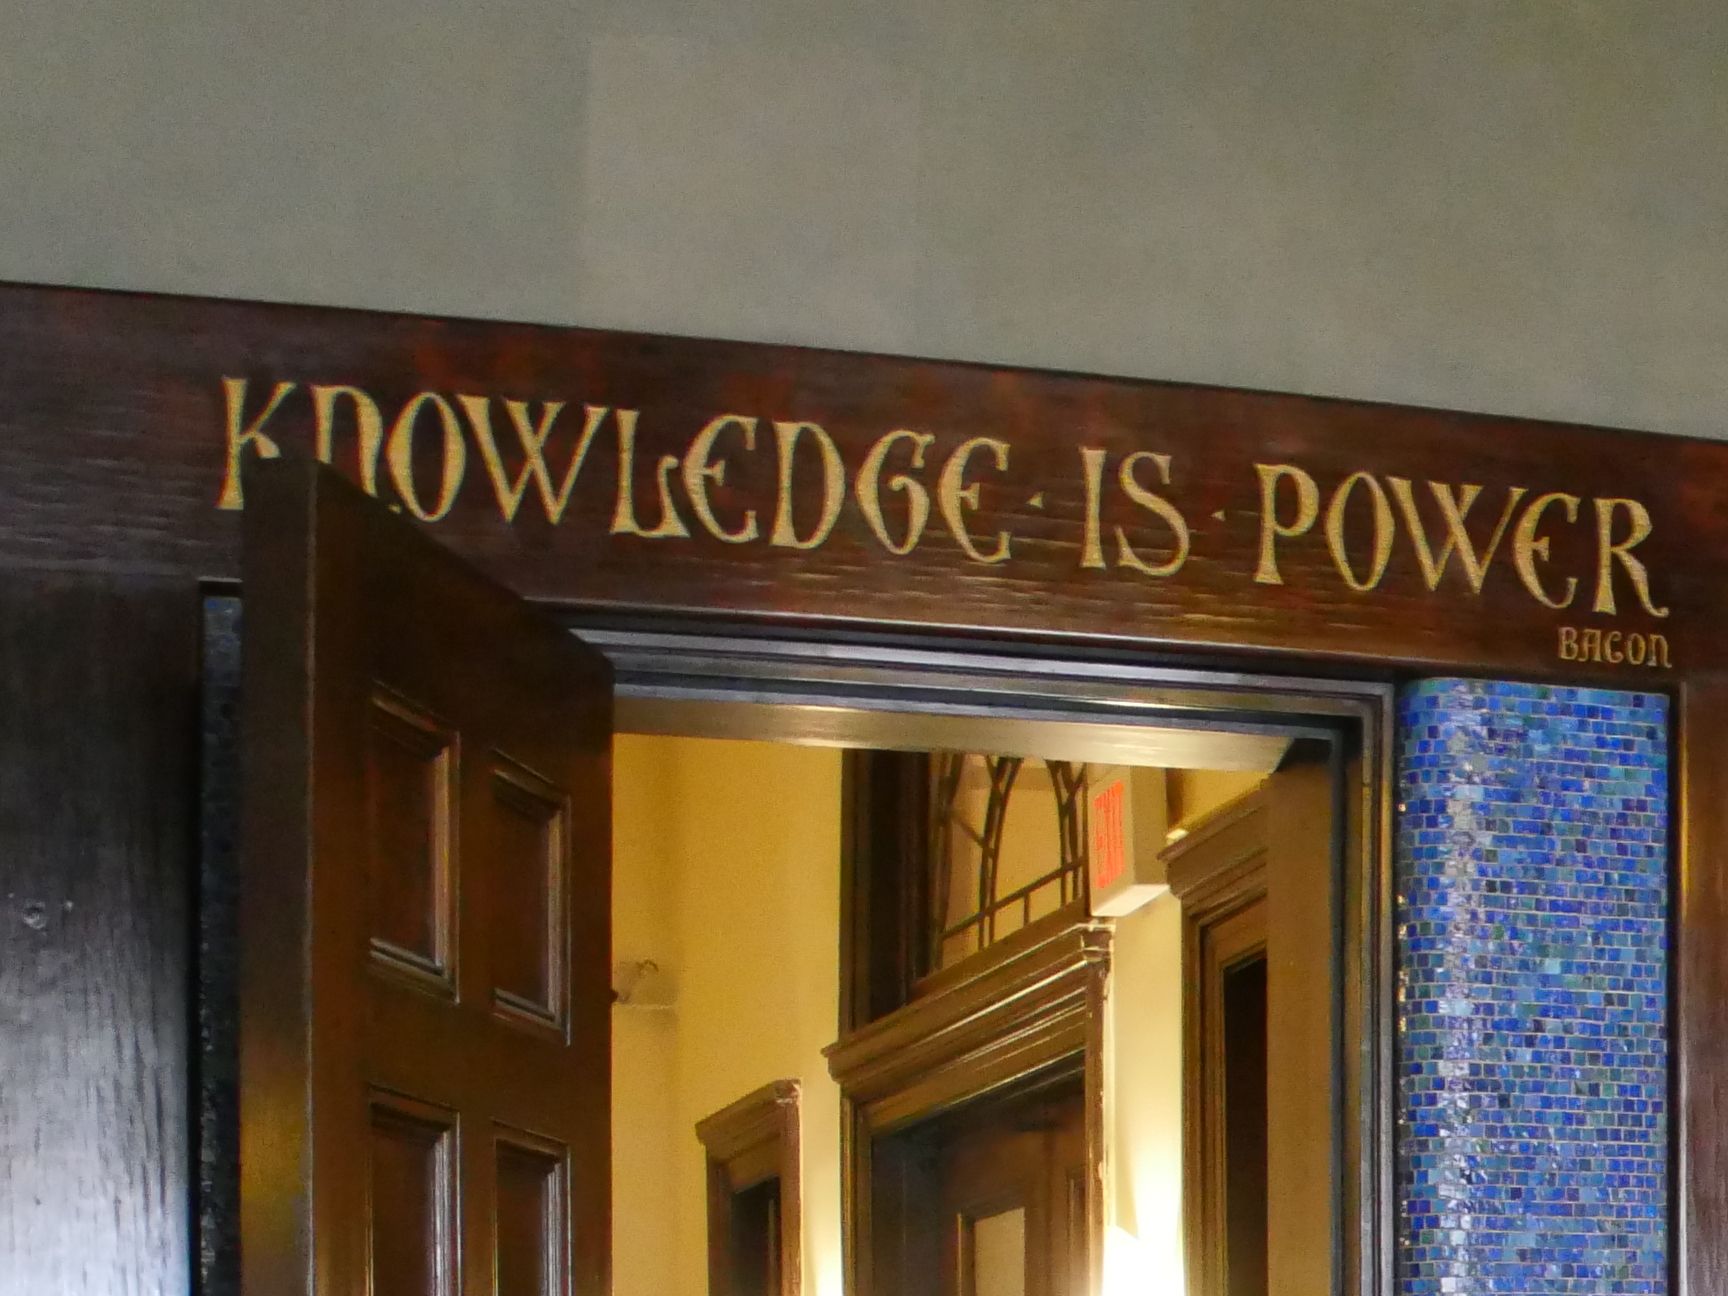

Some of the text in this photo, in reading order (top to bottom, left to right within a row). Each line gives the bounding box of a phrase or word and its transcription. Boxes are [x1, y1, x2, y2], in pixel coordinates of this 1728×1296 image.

[1079, 446, 1191, 578] IS
[1255, 462, 1670, 618] POWER
[1558, 627, 1672, 668] BACON
